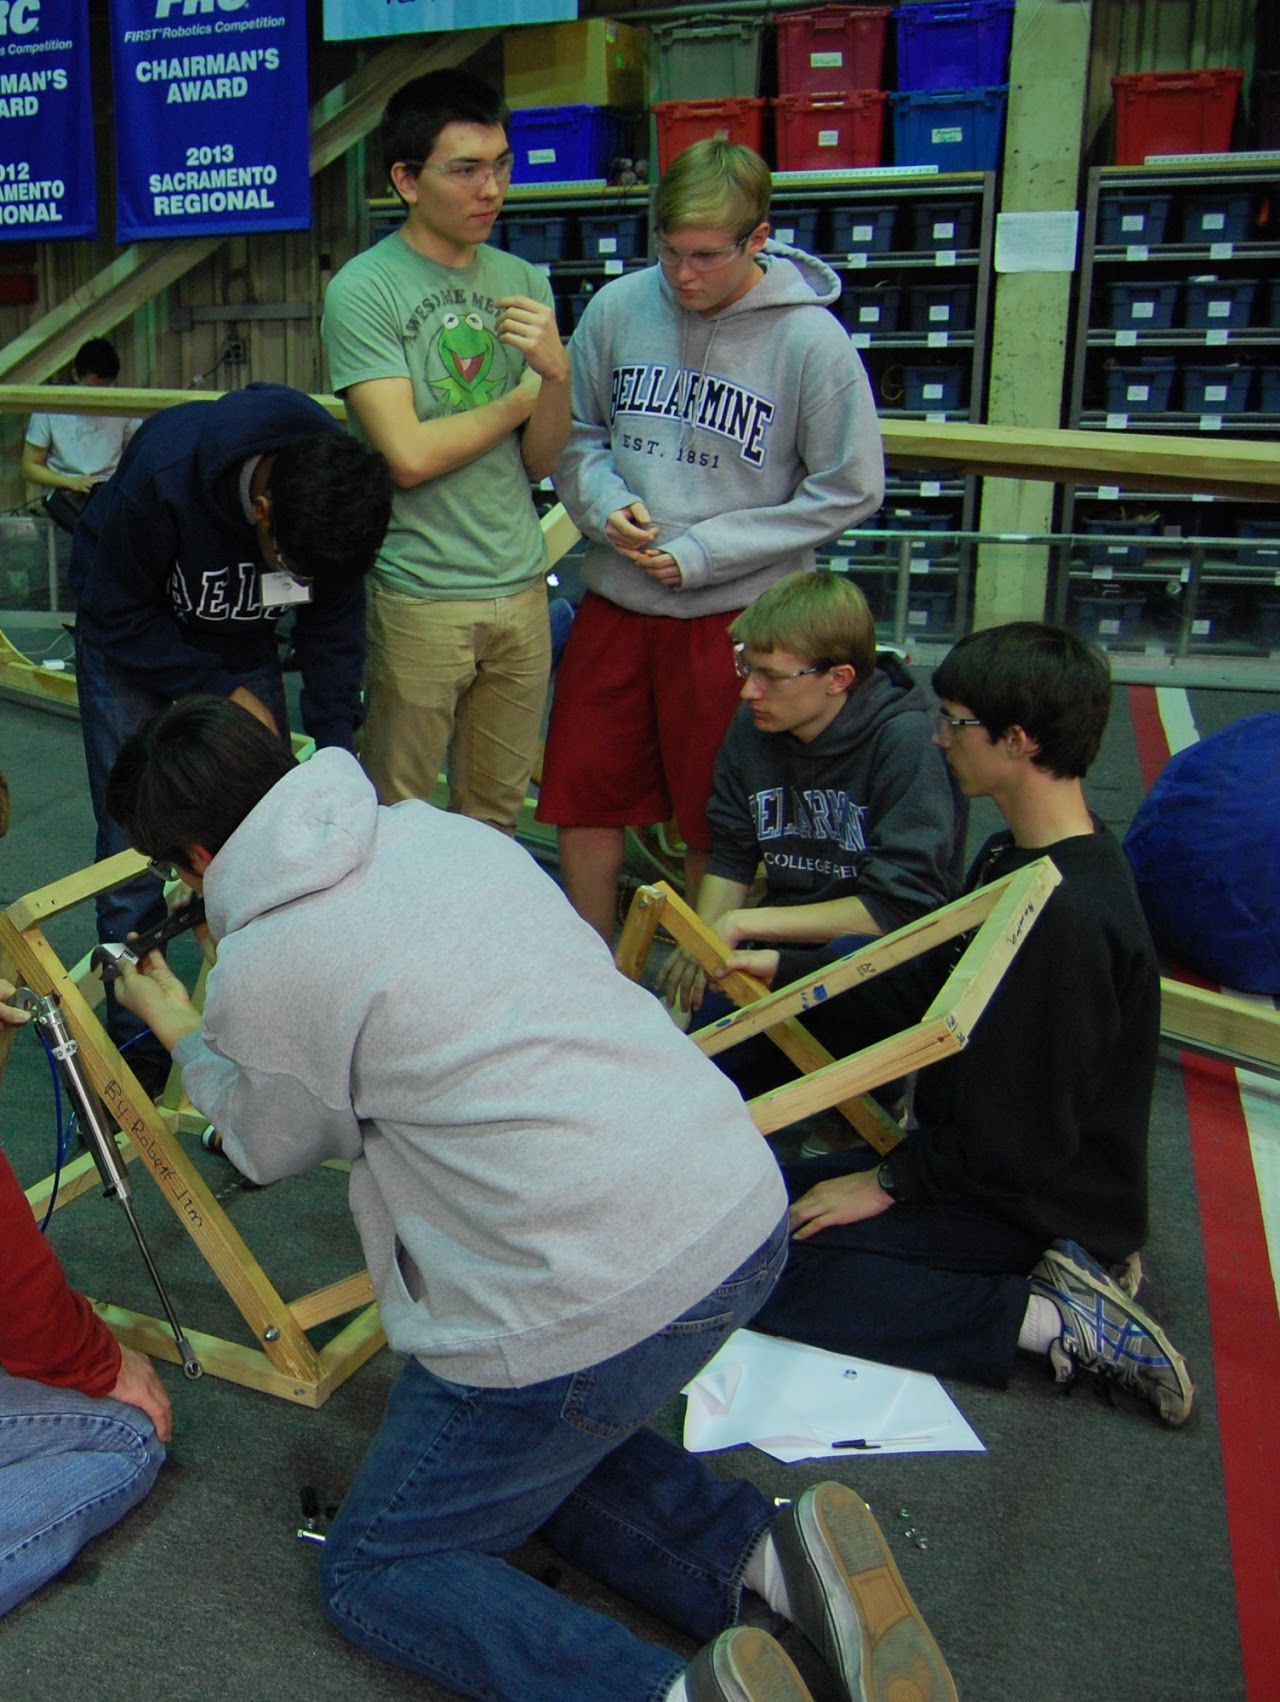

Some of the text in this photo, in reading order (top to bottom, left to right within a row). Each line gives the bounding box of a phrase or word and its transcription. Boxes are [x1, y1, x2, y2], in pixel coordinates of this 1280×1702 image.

[162, 24, 211, 39] Robotics
[214, 16, 285, 32] Competition
[8, 39, 73, 55] Competition
[136, 48, 280, 82] CHAIRMAN'S
[166, 77, 248, 104] AWARD
[186, 144, 235, 166] 2013
[149, 165, 277, 193] SACRAMENTO
[154, 189, 274, 216] REGIONAL
[623, 434, 720, 469] EST. 1851
[764, 852, 832, 873] COLLEGE
[131, 1118, 176, 1181] Robert
